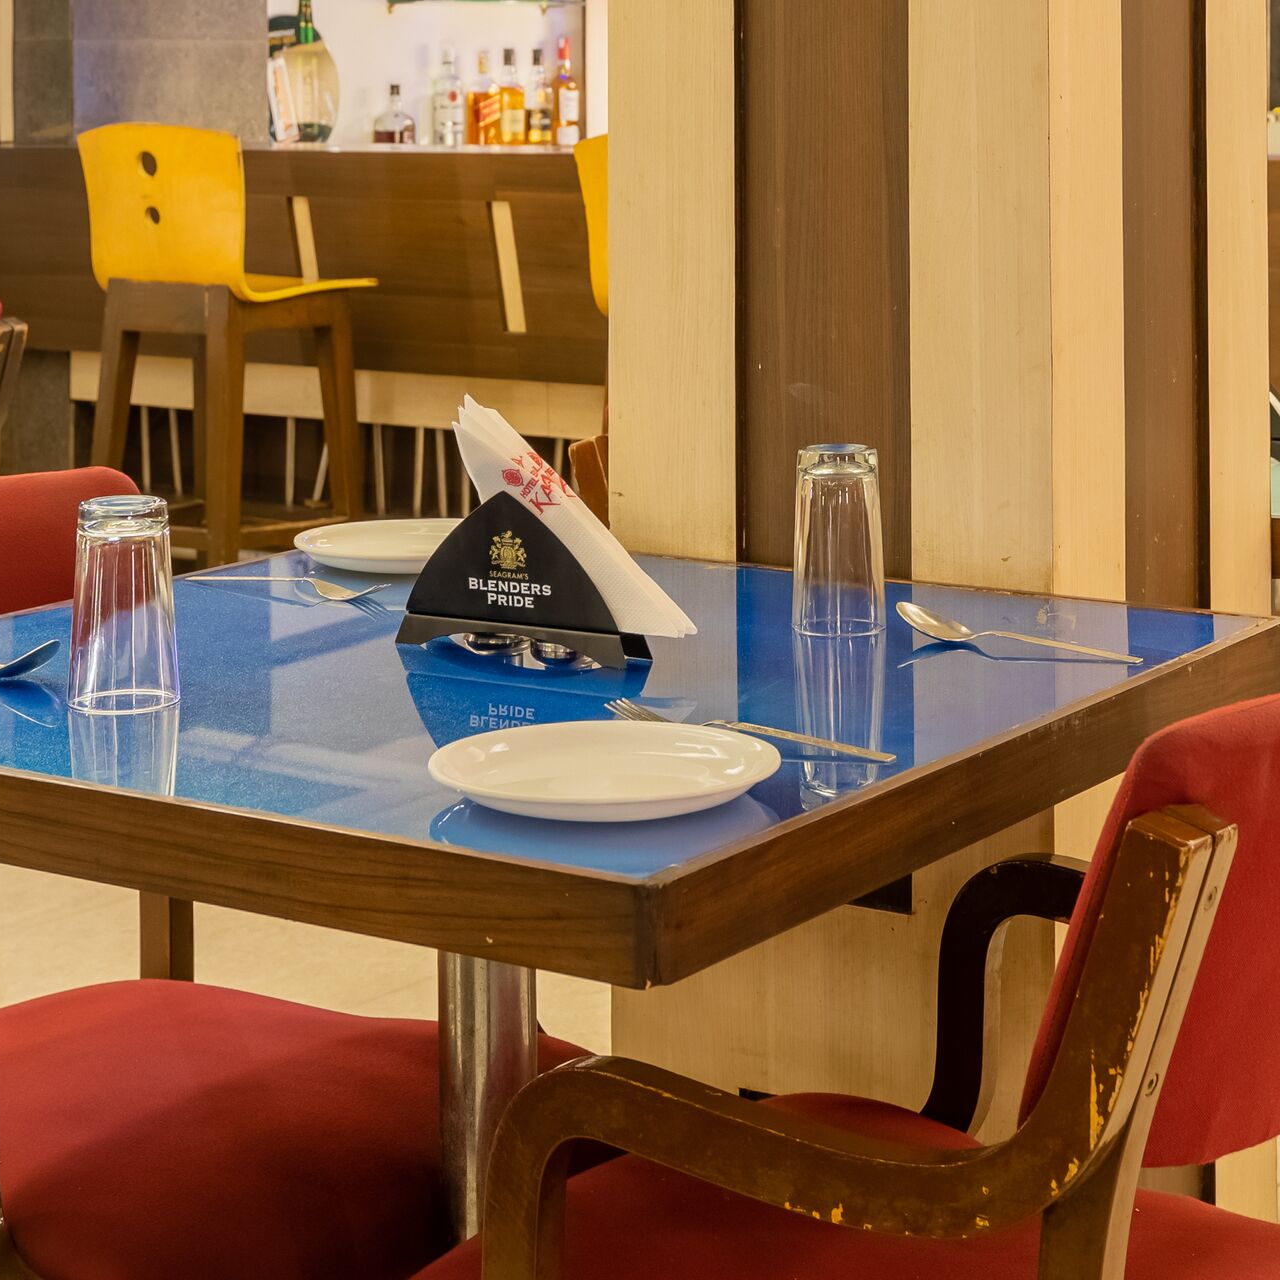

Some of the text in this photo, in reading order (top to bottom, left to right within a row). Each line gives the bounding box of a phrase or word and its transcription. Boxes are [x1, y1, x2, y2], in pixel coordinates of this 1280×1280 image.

[520, 477, 540, 499] HOTEL
[489, 570, 529, 580] SEAGRAM'S
[468, 577, 552, 596] BLENDERS
[487, 592, 535, 609] PRIDE
